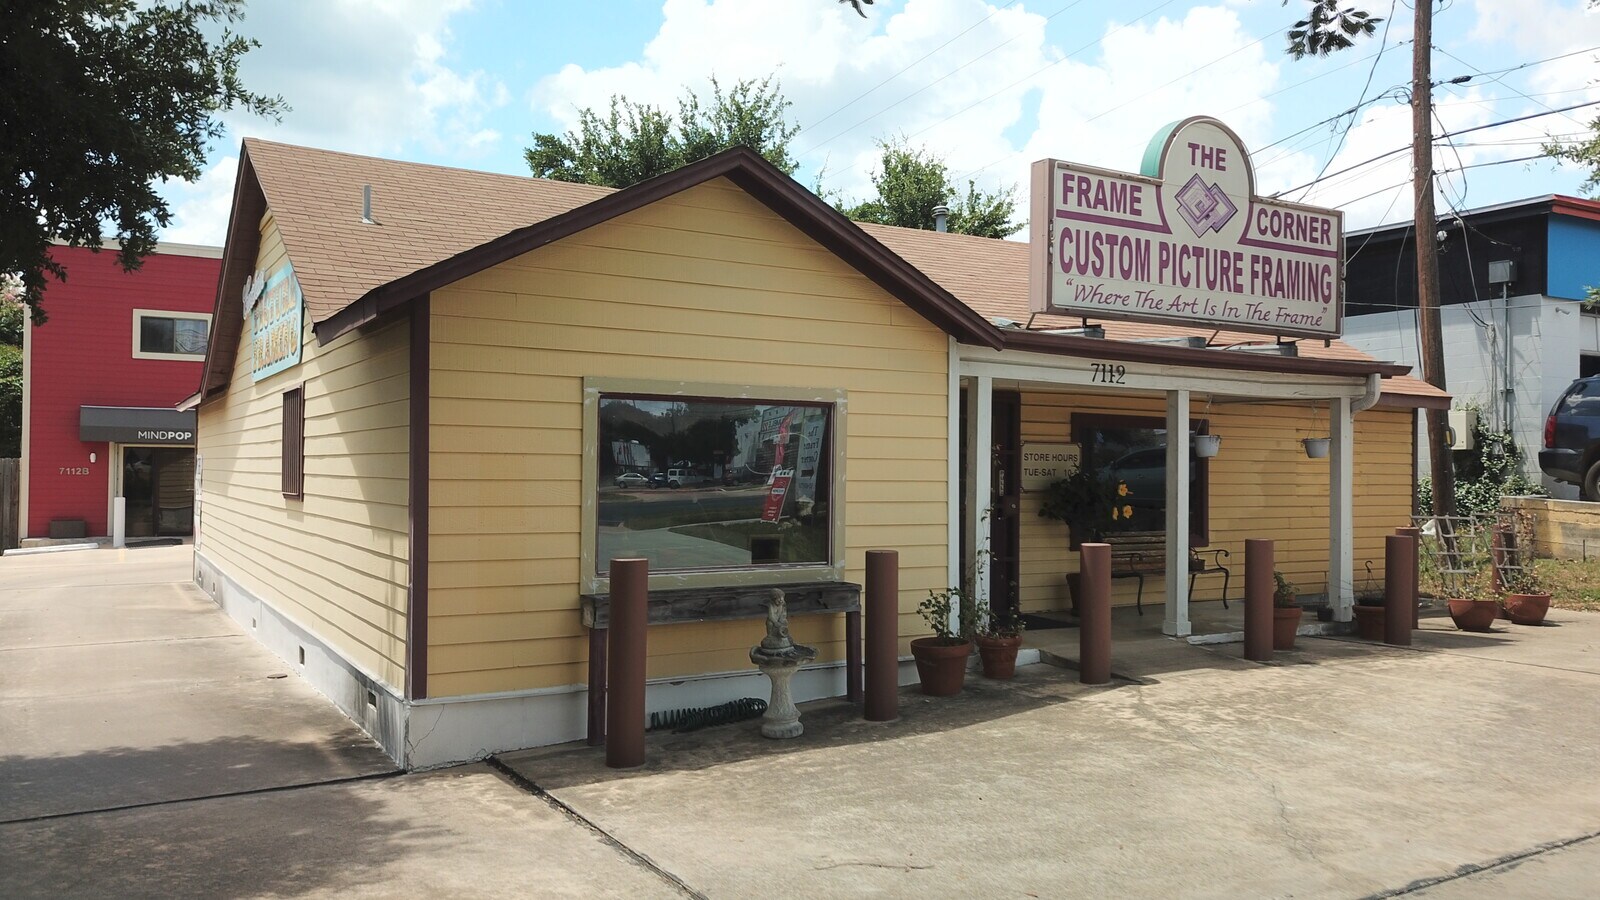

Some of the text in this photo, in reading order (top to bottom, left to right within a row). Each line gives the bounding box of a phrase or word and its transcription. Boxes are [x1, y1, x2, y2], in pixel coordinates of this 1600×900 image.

[1187, 142, 1227, 172] THE
[1061, 172, 1143, 217] FRAME
[1256, 207, 1332, 246] CORNER
[1059, 226, 1332, 305] CUSTOM PICTURE FRAMING
[1134, 289, 1164, 310] The
[1165, 294, 1199, 315] Art
[1202, 298, 1218, 316] Is
[1221, 300, 1241, 318] In
[1245, 301, 1271, 322] The
[1090, 362, 1126, 385] 7112
[137, 431, 192, 440] MINDPOP
[1023, 453, 1078, 462] STORE HOURS
[59, 467, 90, 475] 7112B
[1023, 468, 1057, 477] TUE-SAT
